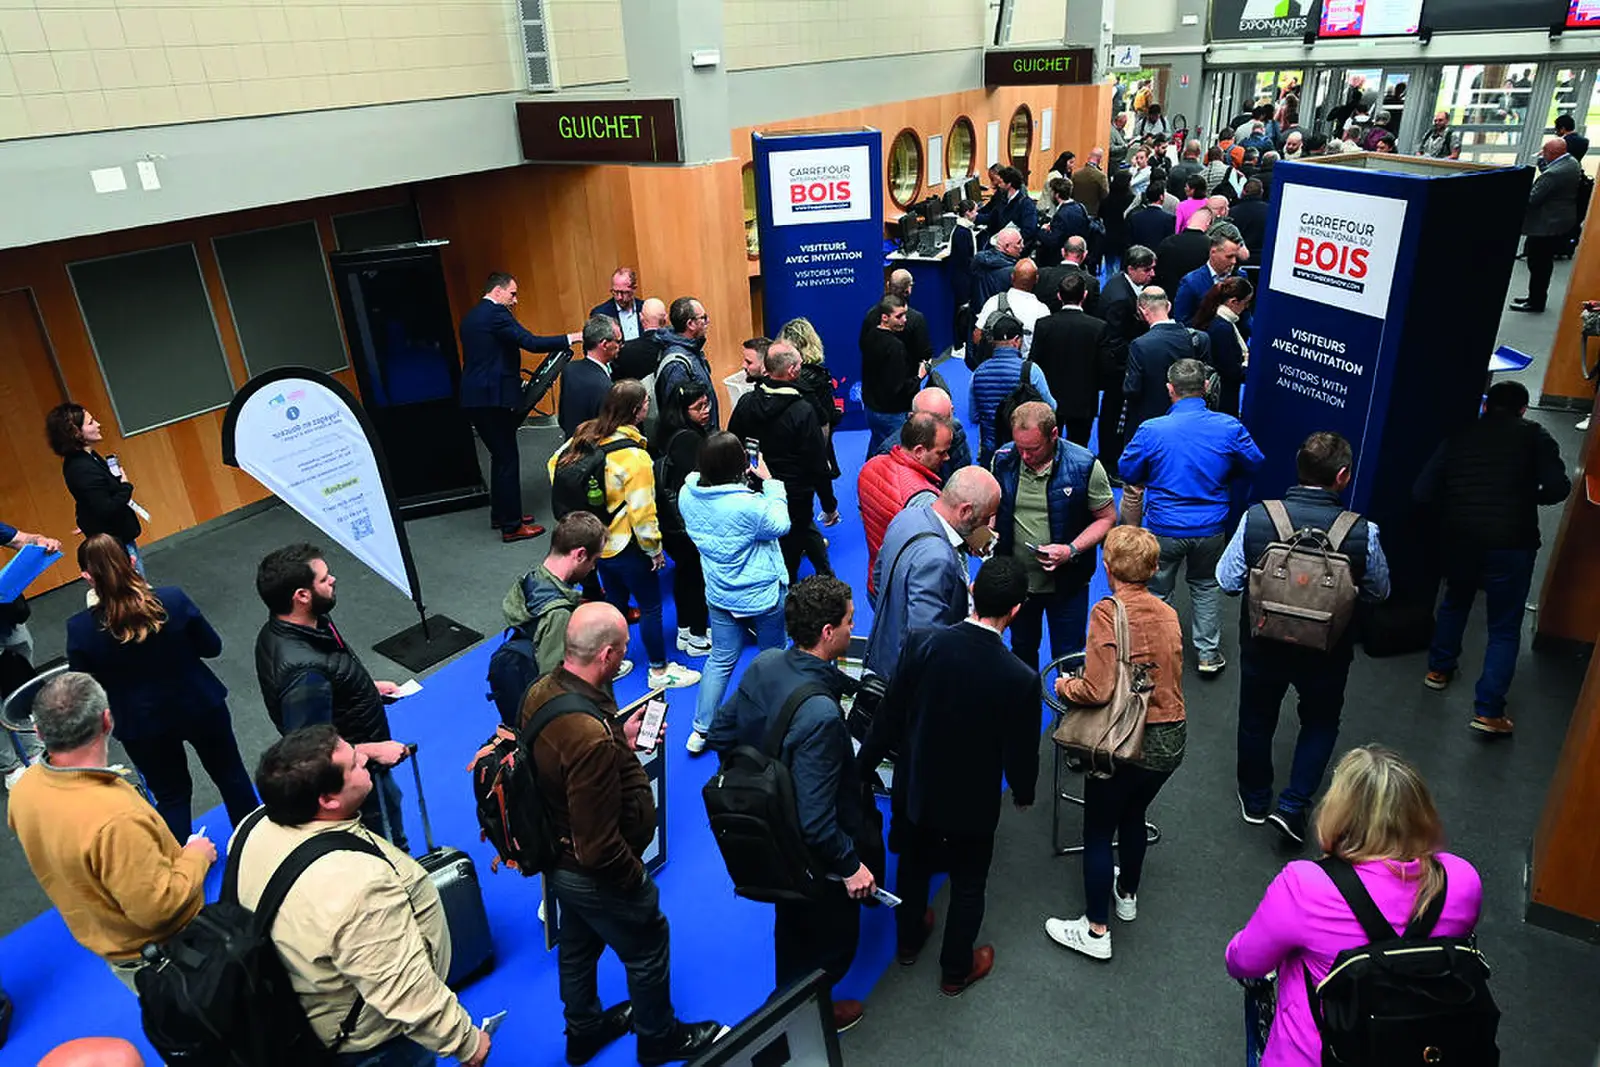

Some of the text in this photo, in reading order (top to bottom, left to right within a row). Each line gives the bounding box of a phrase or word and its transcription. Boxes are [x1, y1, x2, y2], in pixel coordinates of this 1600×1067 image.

[1013, 57, 1071, 72] GUICHET
[559, 115, 642, 139] GUICHET
[789, 165, 850, 177] CARREFOUR
[790, 181, 851, 203] BOIS
[1300, 212, 1375, 237] CARREFOUR
[800, 242, 847, 253] VISITEURS
[1300, 226, 1373, 247] INTERNATIONAL DU
[785, 251, 862, 264] AVEC INVITATION
[1294, 236, 1370, 279] BOIS
[795, 267, 854, 279] VISITORS WITH
[796, 276, 854, 288] AN INVITATION
[1291, 328, 1346, 354] VISITEURS
[1271, 338, 1363, 376] AVEC INVITATION
[1279, 363, 1348, 395] VISITORS WITH
[1276, 377, 1346, 409] AN INVITATION
